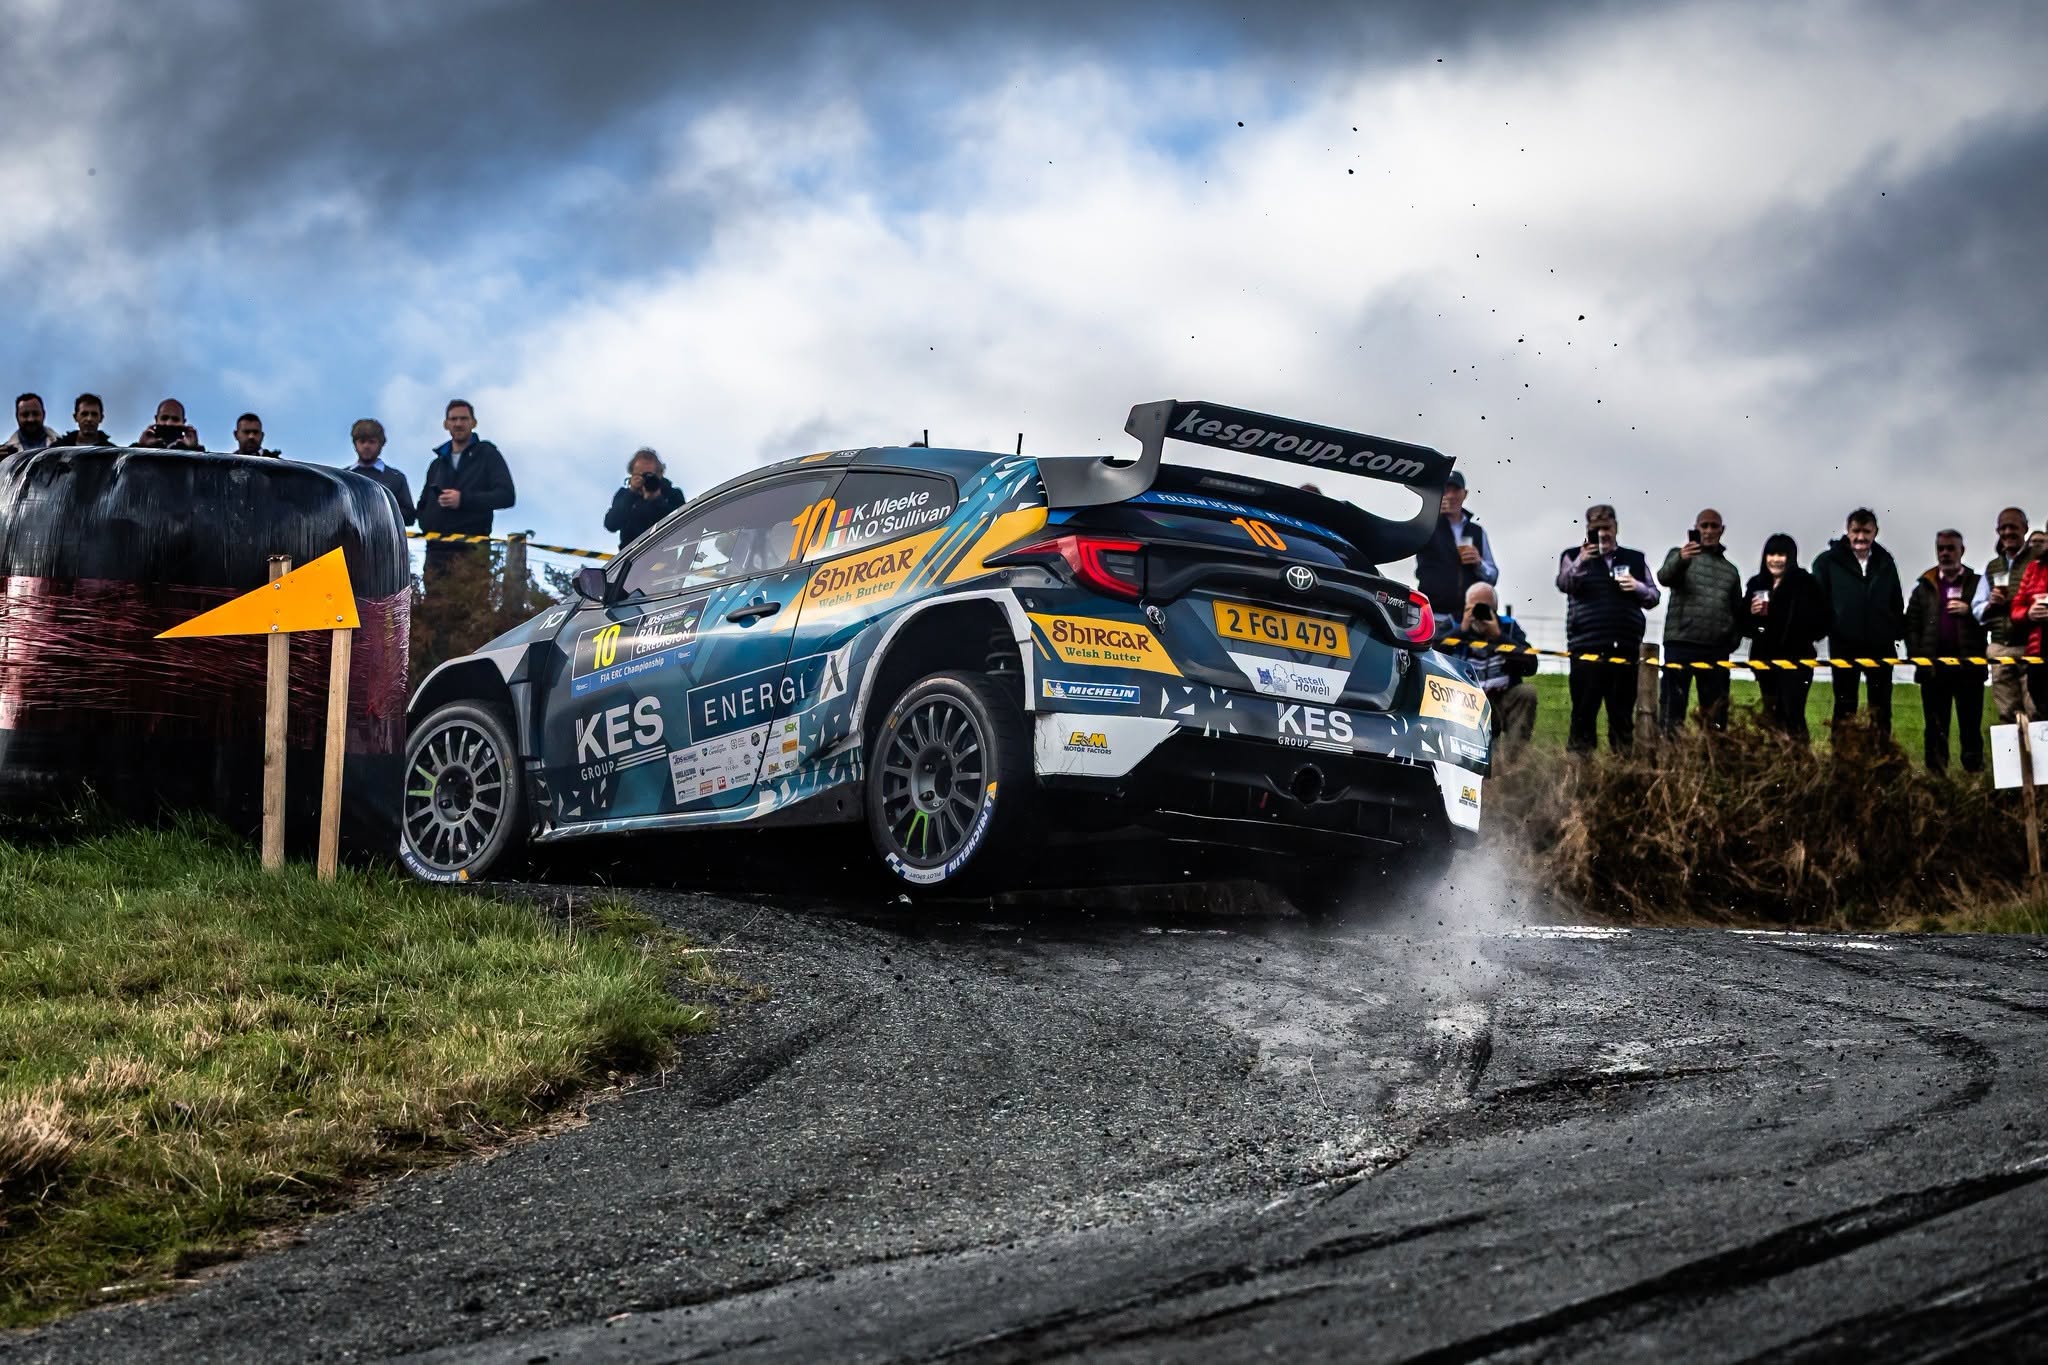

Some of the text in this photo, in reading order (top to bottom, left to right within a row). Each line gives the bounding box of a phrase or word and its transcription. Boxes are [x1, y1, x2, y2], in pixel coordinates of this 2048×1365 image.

[1174, 409, 1425, 478] kesgroup.com
[1157, 494, 1208, 506] FOLLOW
[1208, 500, 1228, 509] US
[789, 498, 837, 561] 10
[1230, 516, 1287, 551] 10
[819, 579, 896, 608] Welsh Butter
[1227, 609, 1337, 649] 2 FGJ 479
[592, 624, 622, 670] 10
[1065, 647, 1141, 662] Welsh Butter
[600, 657, 665, 684] FIA ERC Championship
[1290, 673, 1325, 686] Castell
[1068, 685, 1135, 698] MICHELIN
[1295, 682, 1330, 696] Howell
[576, 696, 664, 764] KES
[1277, 702, 1353, 743] KES
[1064, 745, 1112, 755] MOTOR FACTORS
[1068, 731, 1108, 748] E&M
[1278, 736, 1309, 748] GROUP
[581, 760, 615, 780] GROUP
[949, 811, 989, 872] MICHELIN
[908, 872, 941, 880] PILOT SPORT
